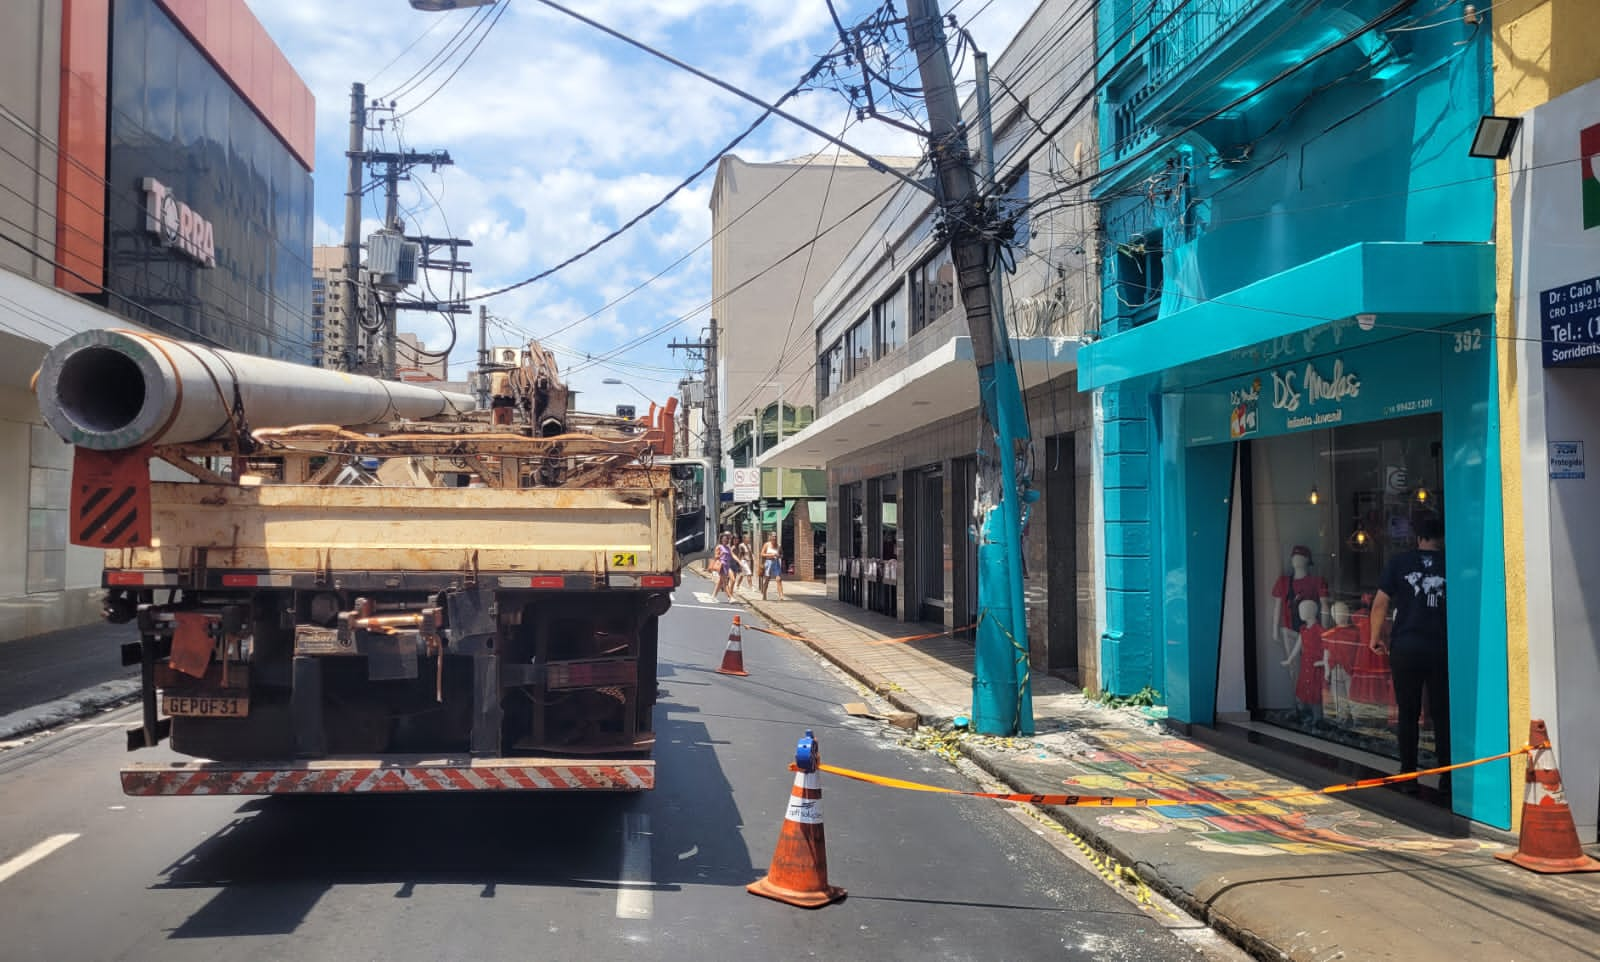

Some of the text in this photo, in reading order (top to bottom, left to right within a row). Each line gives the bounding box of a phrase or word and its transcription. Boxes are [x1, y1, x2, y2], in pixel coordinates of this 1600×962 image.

[143, 177, 216, 268] TORRA
[1569, 283, 1593, 299] Caio
[1549, 306, 1566, 319] CRO
[1454, 328, 1482, 353] 392
[1551, 322, 1582, 342] Tel.:
[1271, 359, 1361, 412] DS Modas
[1314, 408, 1343, 424] Juvenil
[614, 554, 635, 567] 21
